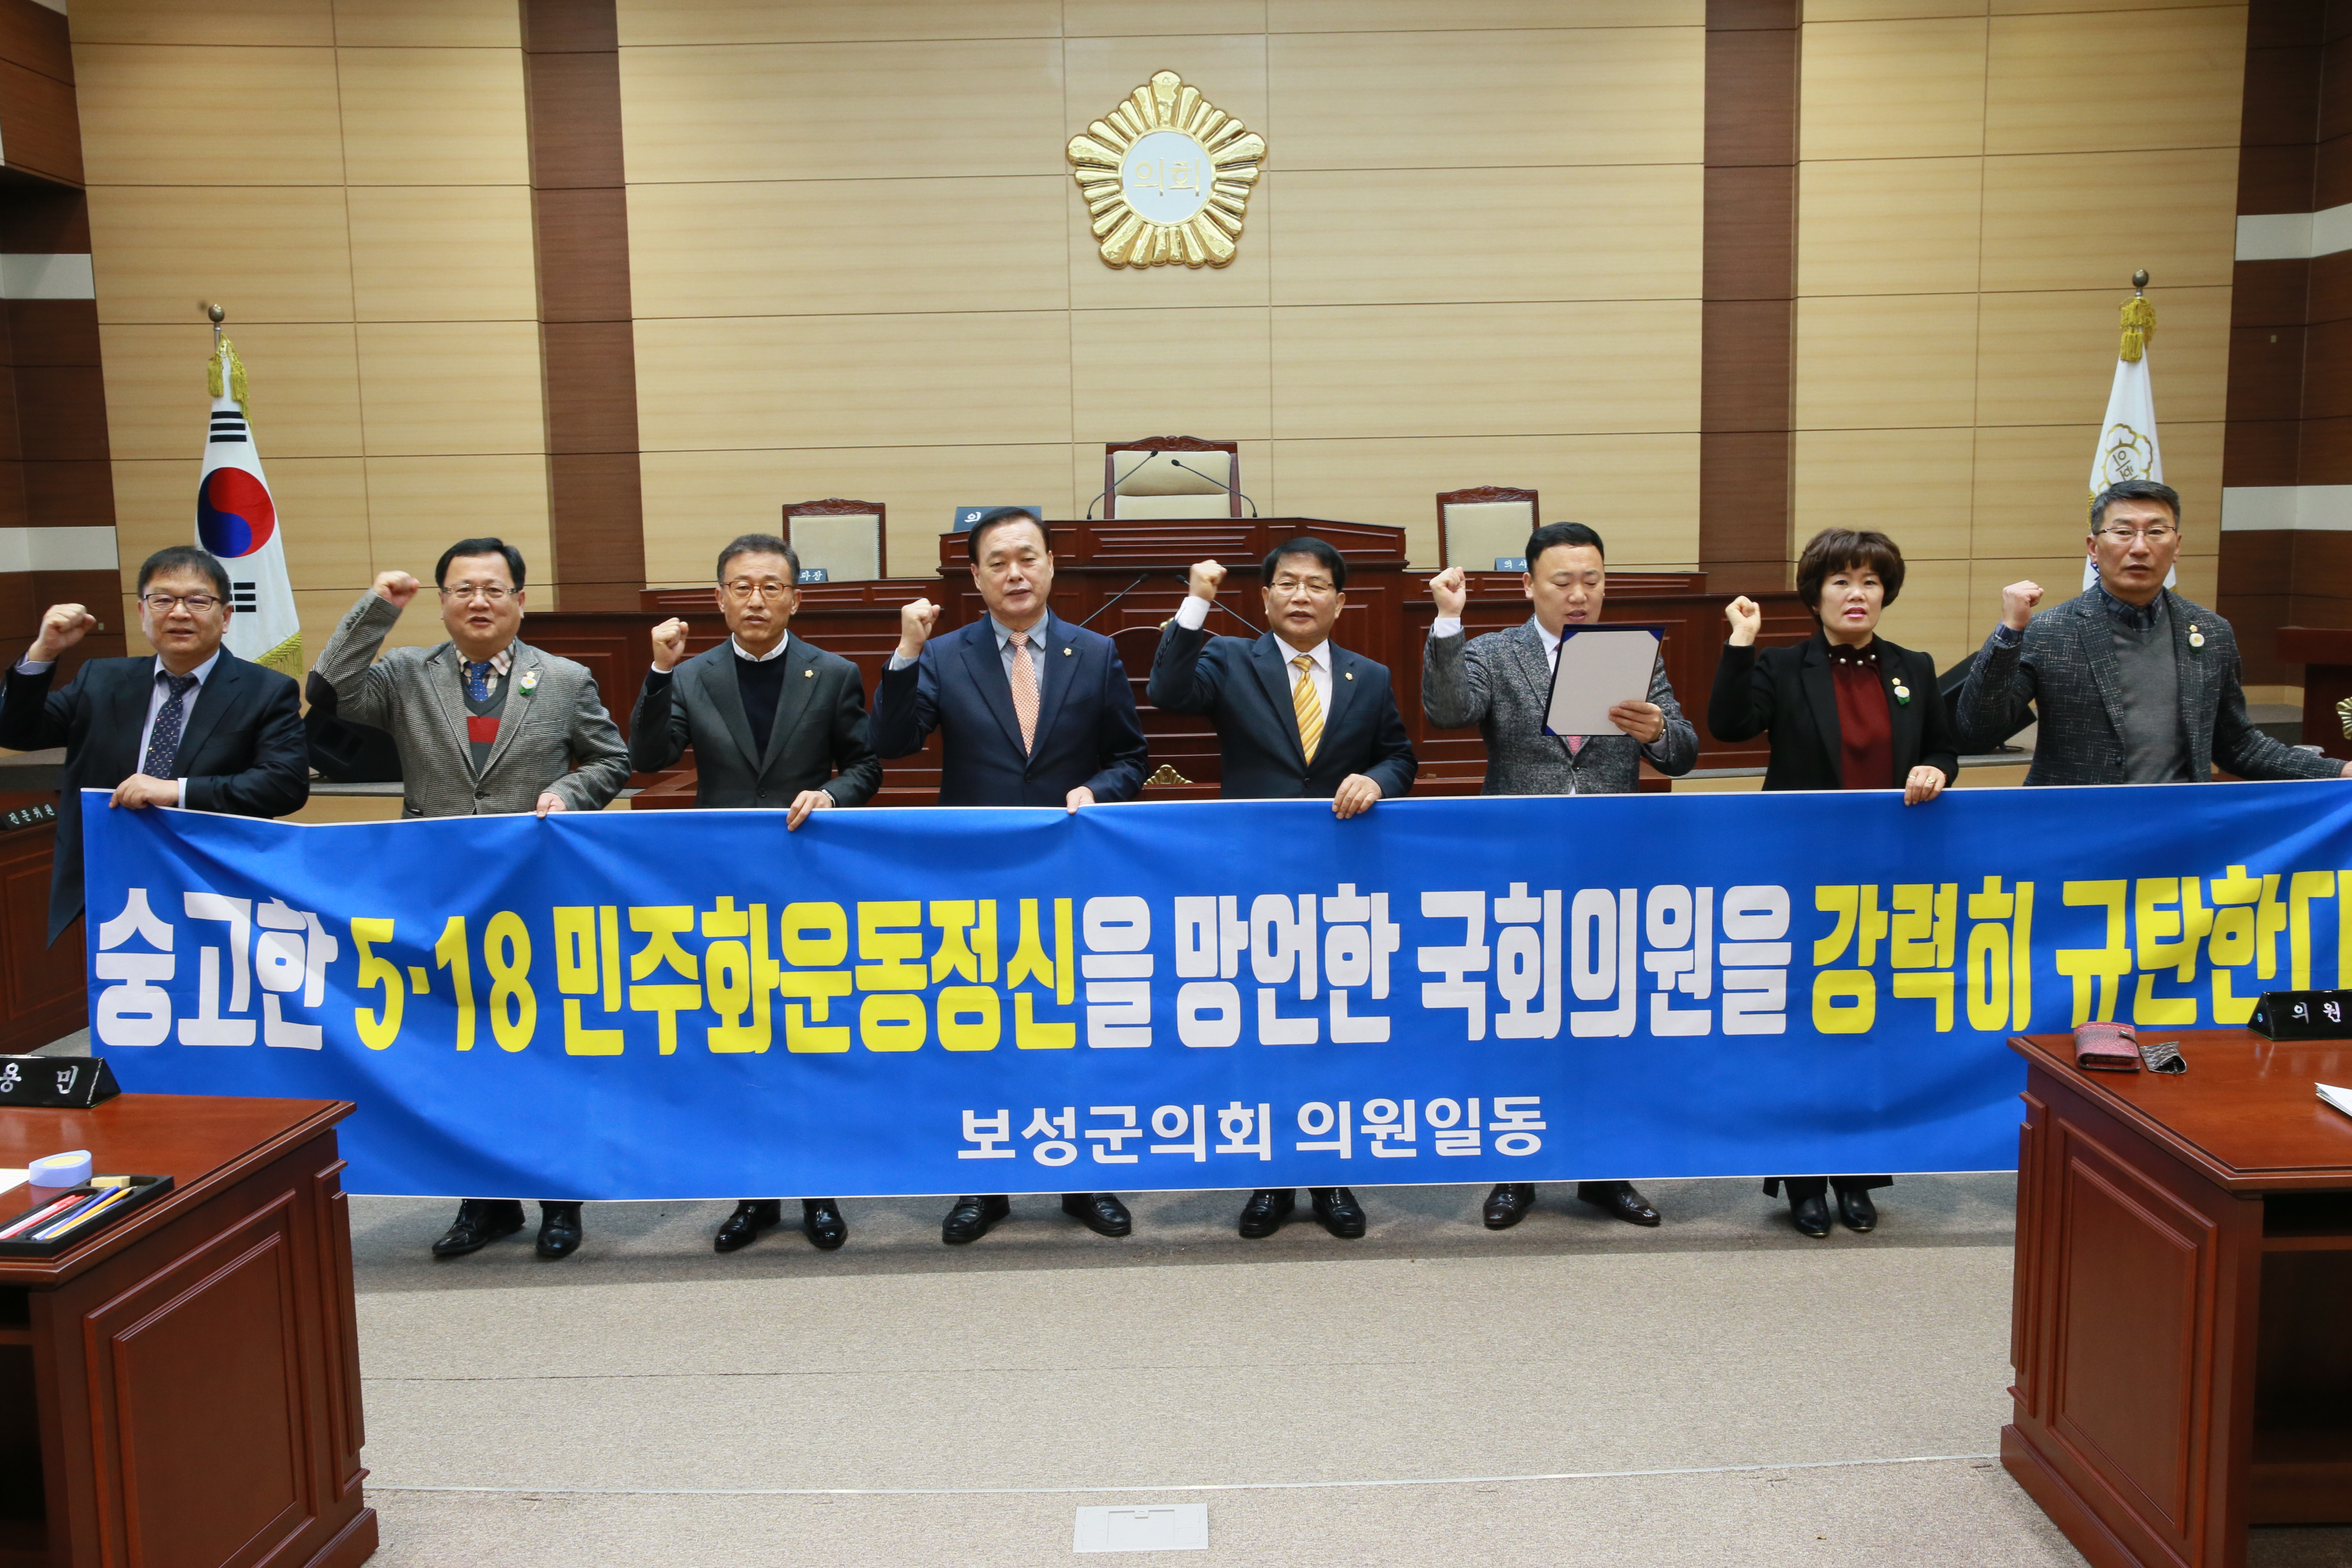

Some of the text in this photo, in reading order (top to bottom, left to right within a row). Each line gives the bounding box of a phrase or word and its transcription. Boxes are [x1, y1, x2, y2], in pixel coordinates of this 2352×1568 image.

[1133, 157, 1200, 196] 의회
[96, 888, 338, 1050] 숭고한
[553, 896, 1154, 1056] 민주화운동정신을
[1174, 883, 1400, 1048] 망언한
[1417, 882, 1792, 1041] 국회의원을
[1812, 876, 2034, 1034] 강력히
[958, 1096, 1546, 1166] 보성군의회 의원일동
